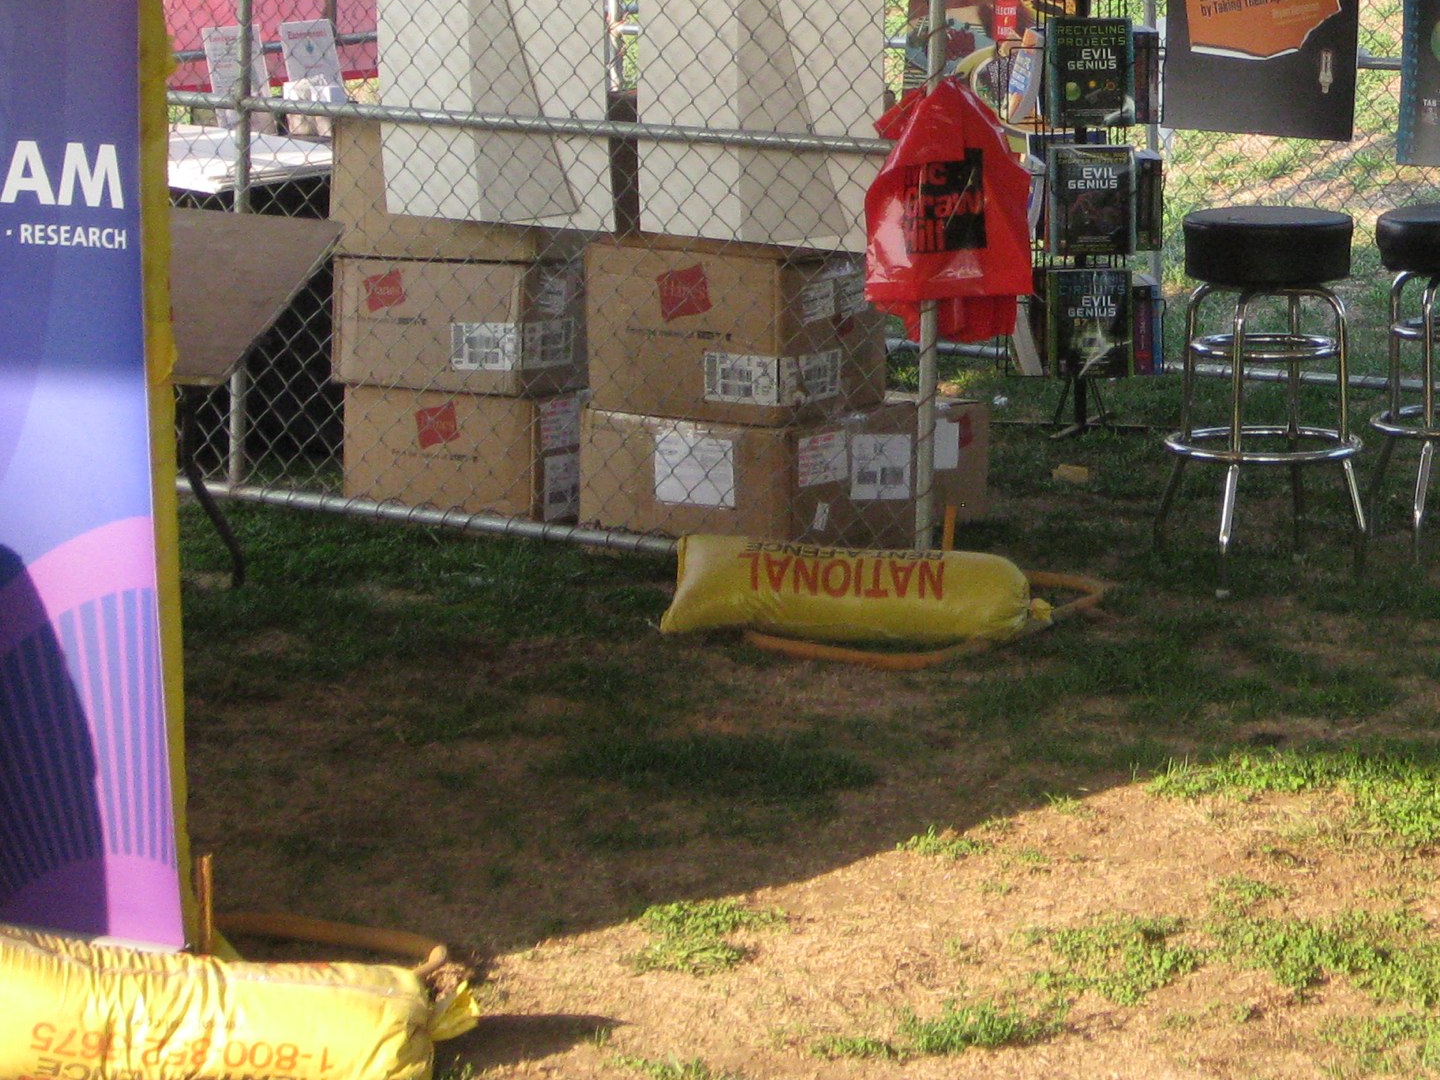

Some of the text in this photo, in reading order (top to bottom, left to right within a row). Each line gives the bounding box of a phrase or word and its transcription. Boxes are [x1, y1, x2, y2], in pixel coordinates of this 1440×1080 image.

[1200, 3, 1212, 17] by
[1057, 25, 1126, 35] RECYCLING
[1057, 37, 1126, 46] PROJECTS
[1082, 48, 1117, 60] EVIL
[1068, 60, 1117, 70] GENIUS
[1082, 167, 1118, 179] EVIL
[1068, 179, 1118, 190] GENIUS
[20, 223, 128, 250] RESEARCH
[1082, 295, 1116, 307] EVIL
[1068, 307, 1117, 317] GENIUS
[738, 552, 944, 601] NATIONAL
